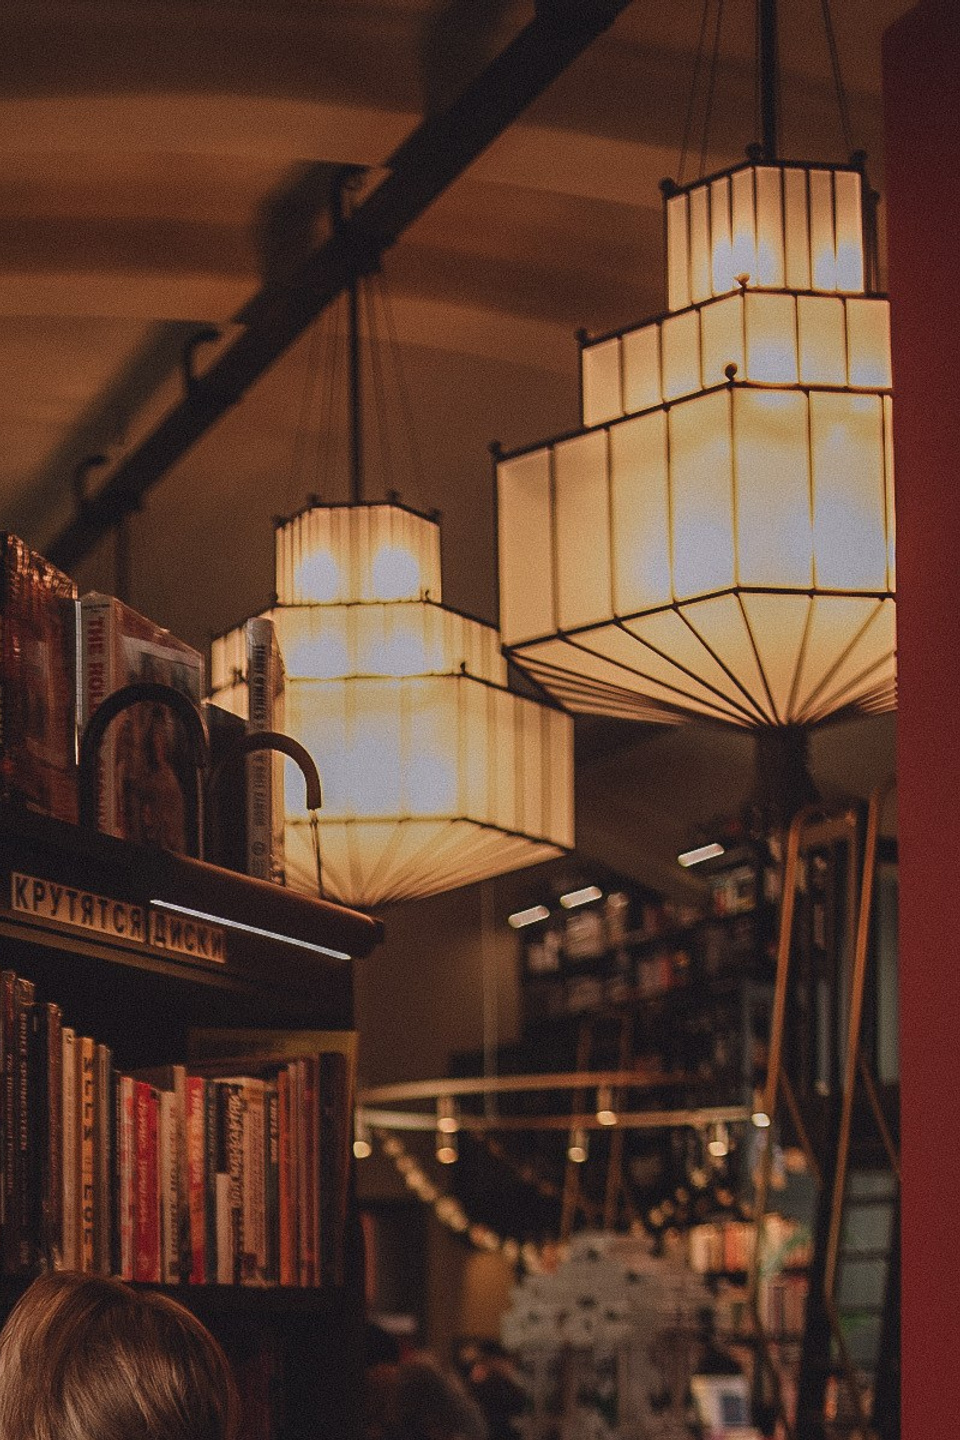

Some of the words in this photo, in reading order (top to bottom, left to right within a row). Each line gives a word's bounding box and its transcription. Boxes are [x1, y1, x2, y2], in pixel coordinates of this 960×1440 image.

[87, 616, 104, 655] THE
[253, 644, 266, 676] TERRY
[87, 662, 104, 718] ROLL
[15, 876, 142, 941] КРУТЯТСЯ
[155, 912, 224, 960] ДИСКИ
[19, 1012, 28, 1055] BRUCE
[19, 1060, 28, 1152] SPRINGSTEEN
